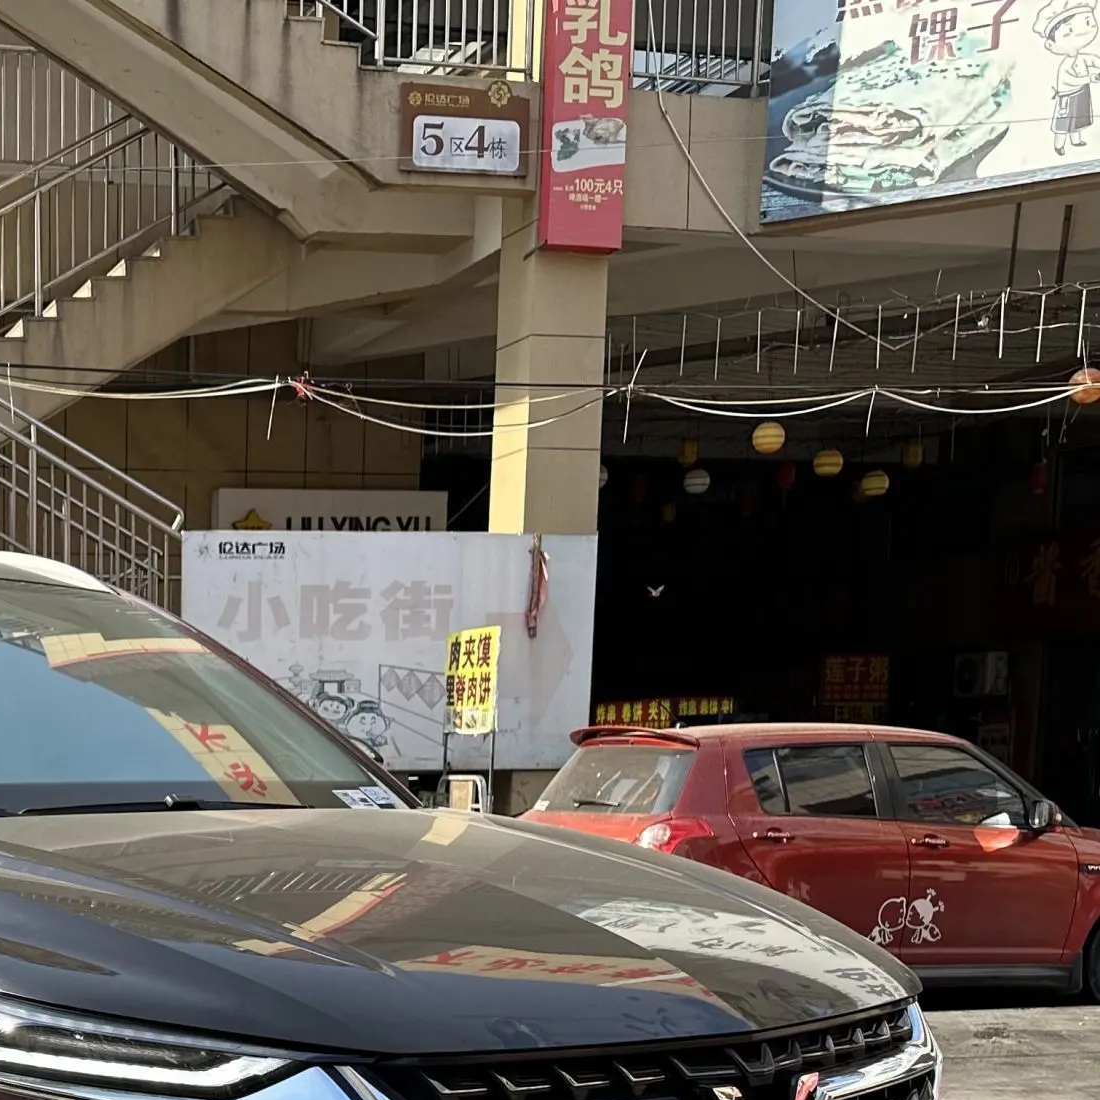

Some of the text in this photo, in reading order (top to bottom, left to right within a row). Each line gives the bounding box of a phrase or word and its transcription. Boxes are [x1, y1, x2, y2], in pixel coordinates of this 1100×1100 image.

[559, 0, 628, 108] 乳鸽
[420, 122, 507, 159] 5区4栋
[574, 178, 623, 196] 100元4只
[218, 541, 286, 554] 伦达广场
[216, 580, 455, 642] 小吃街
[449, 632, 492, 671] 肉夹馍
[445, 672, 491, 706] 里脊肉饼
